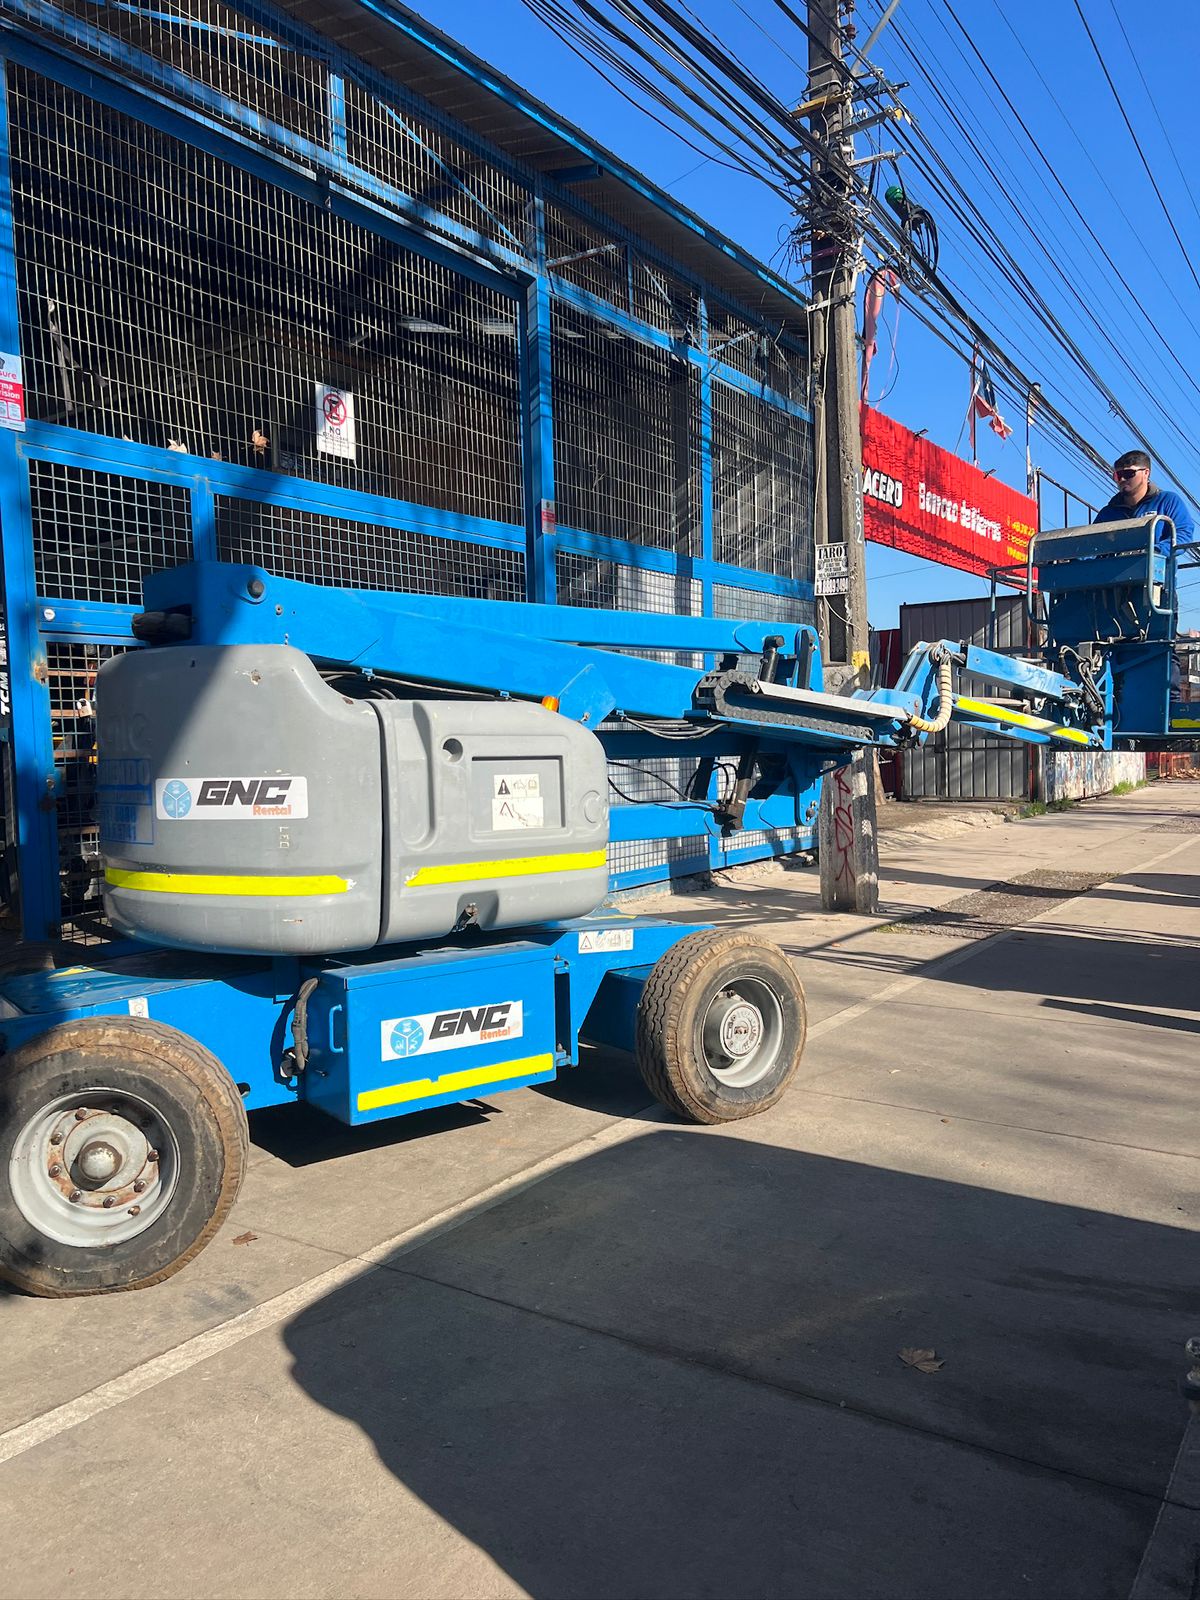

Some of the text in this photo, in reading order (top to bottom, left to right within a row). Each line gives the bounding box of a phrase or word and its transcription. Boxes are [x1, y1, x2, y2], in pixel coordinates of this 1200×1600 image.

[862, 467, 903, 508] ACERO
[818, 546, 848, 559] TAROT
[196, 779, 292, 806] GNC
[253, 804, 292, 816] Rental
[428, 1003, 512, 1041] GNC
[480, 1026, 511, 1041] Rental
